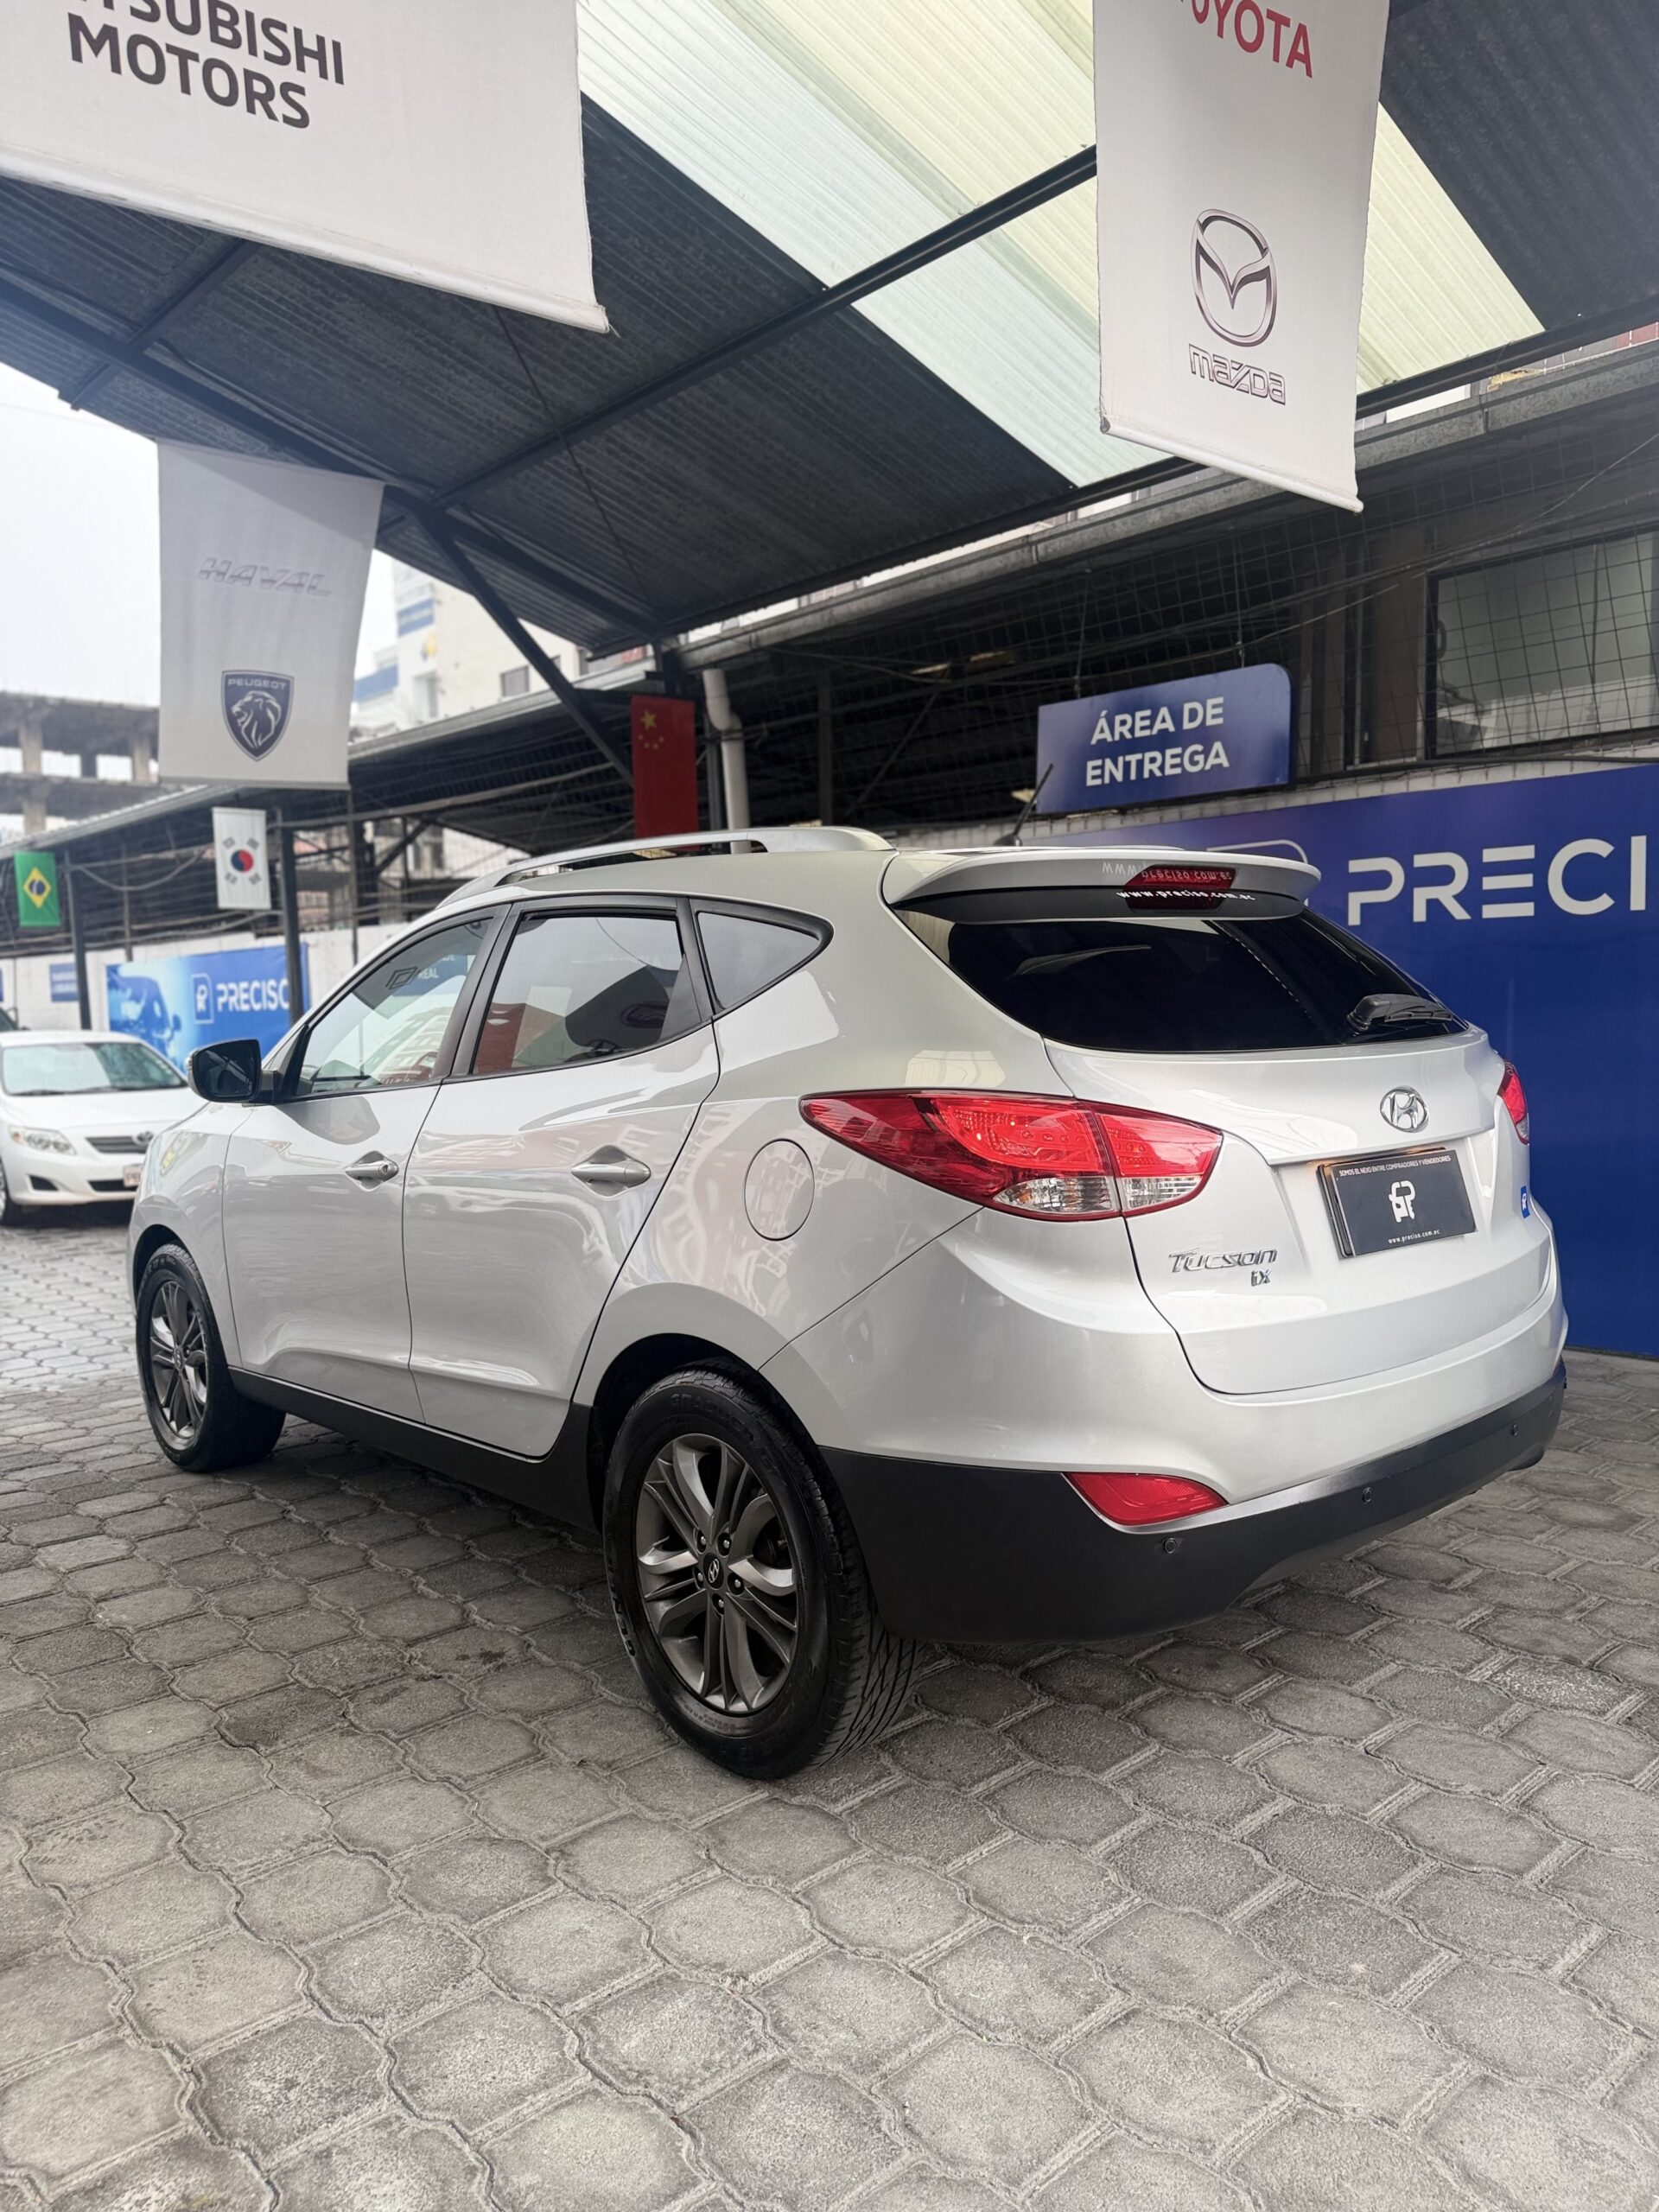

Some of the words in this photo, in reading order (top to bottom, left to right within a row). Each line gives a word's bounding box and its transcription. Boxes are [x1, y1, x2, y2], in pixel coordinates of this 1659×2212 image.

[67, 12, 309, 129] MOTORS
[198, 557, 332, 597] HAVAL
[227, 677, 287, 690] PEUGEOT
[1090, 706, 1176, 745] ÁREA
[1182, 696, 1224, 730] DE
[1085, 741, 1230, 787] ENTREGA
[1116, 890, 1256, 901] www.preciso.com.ec
[1348, 835, 1648, 927] PRECI
[1388, 1229, 1440, 1244] www.preciso.com.ec
[1168, 1247, 1278, 1273] Tucson
